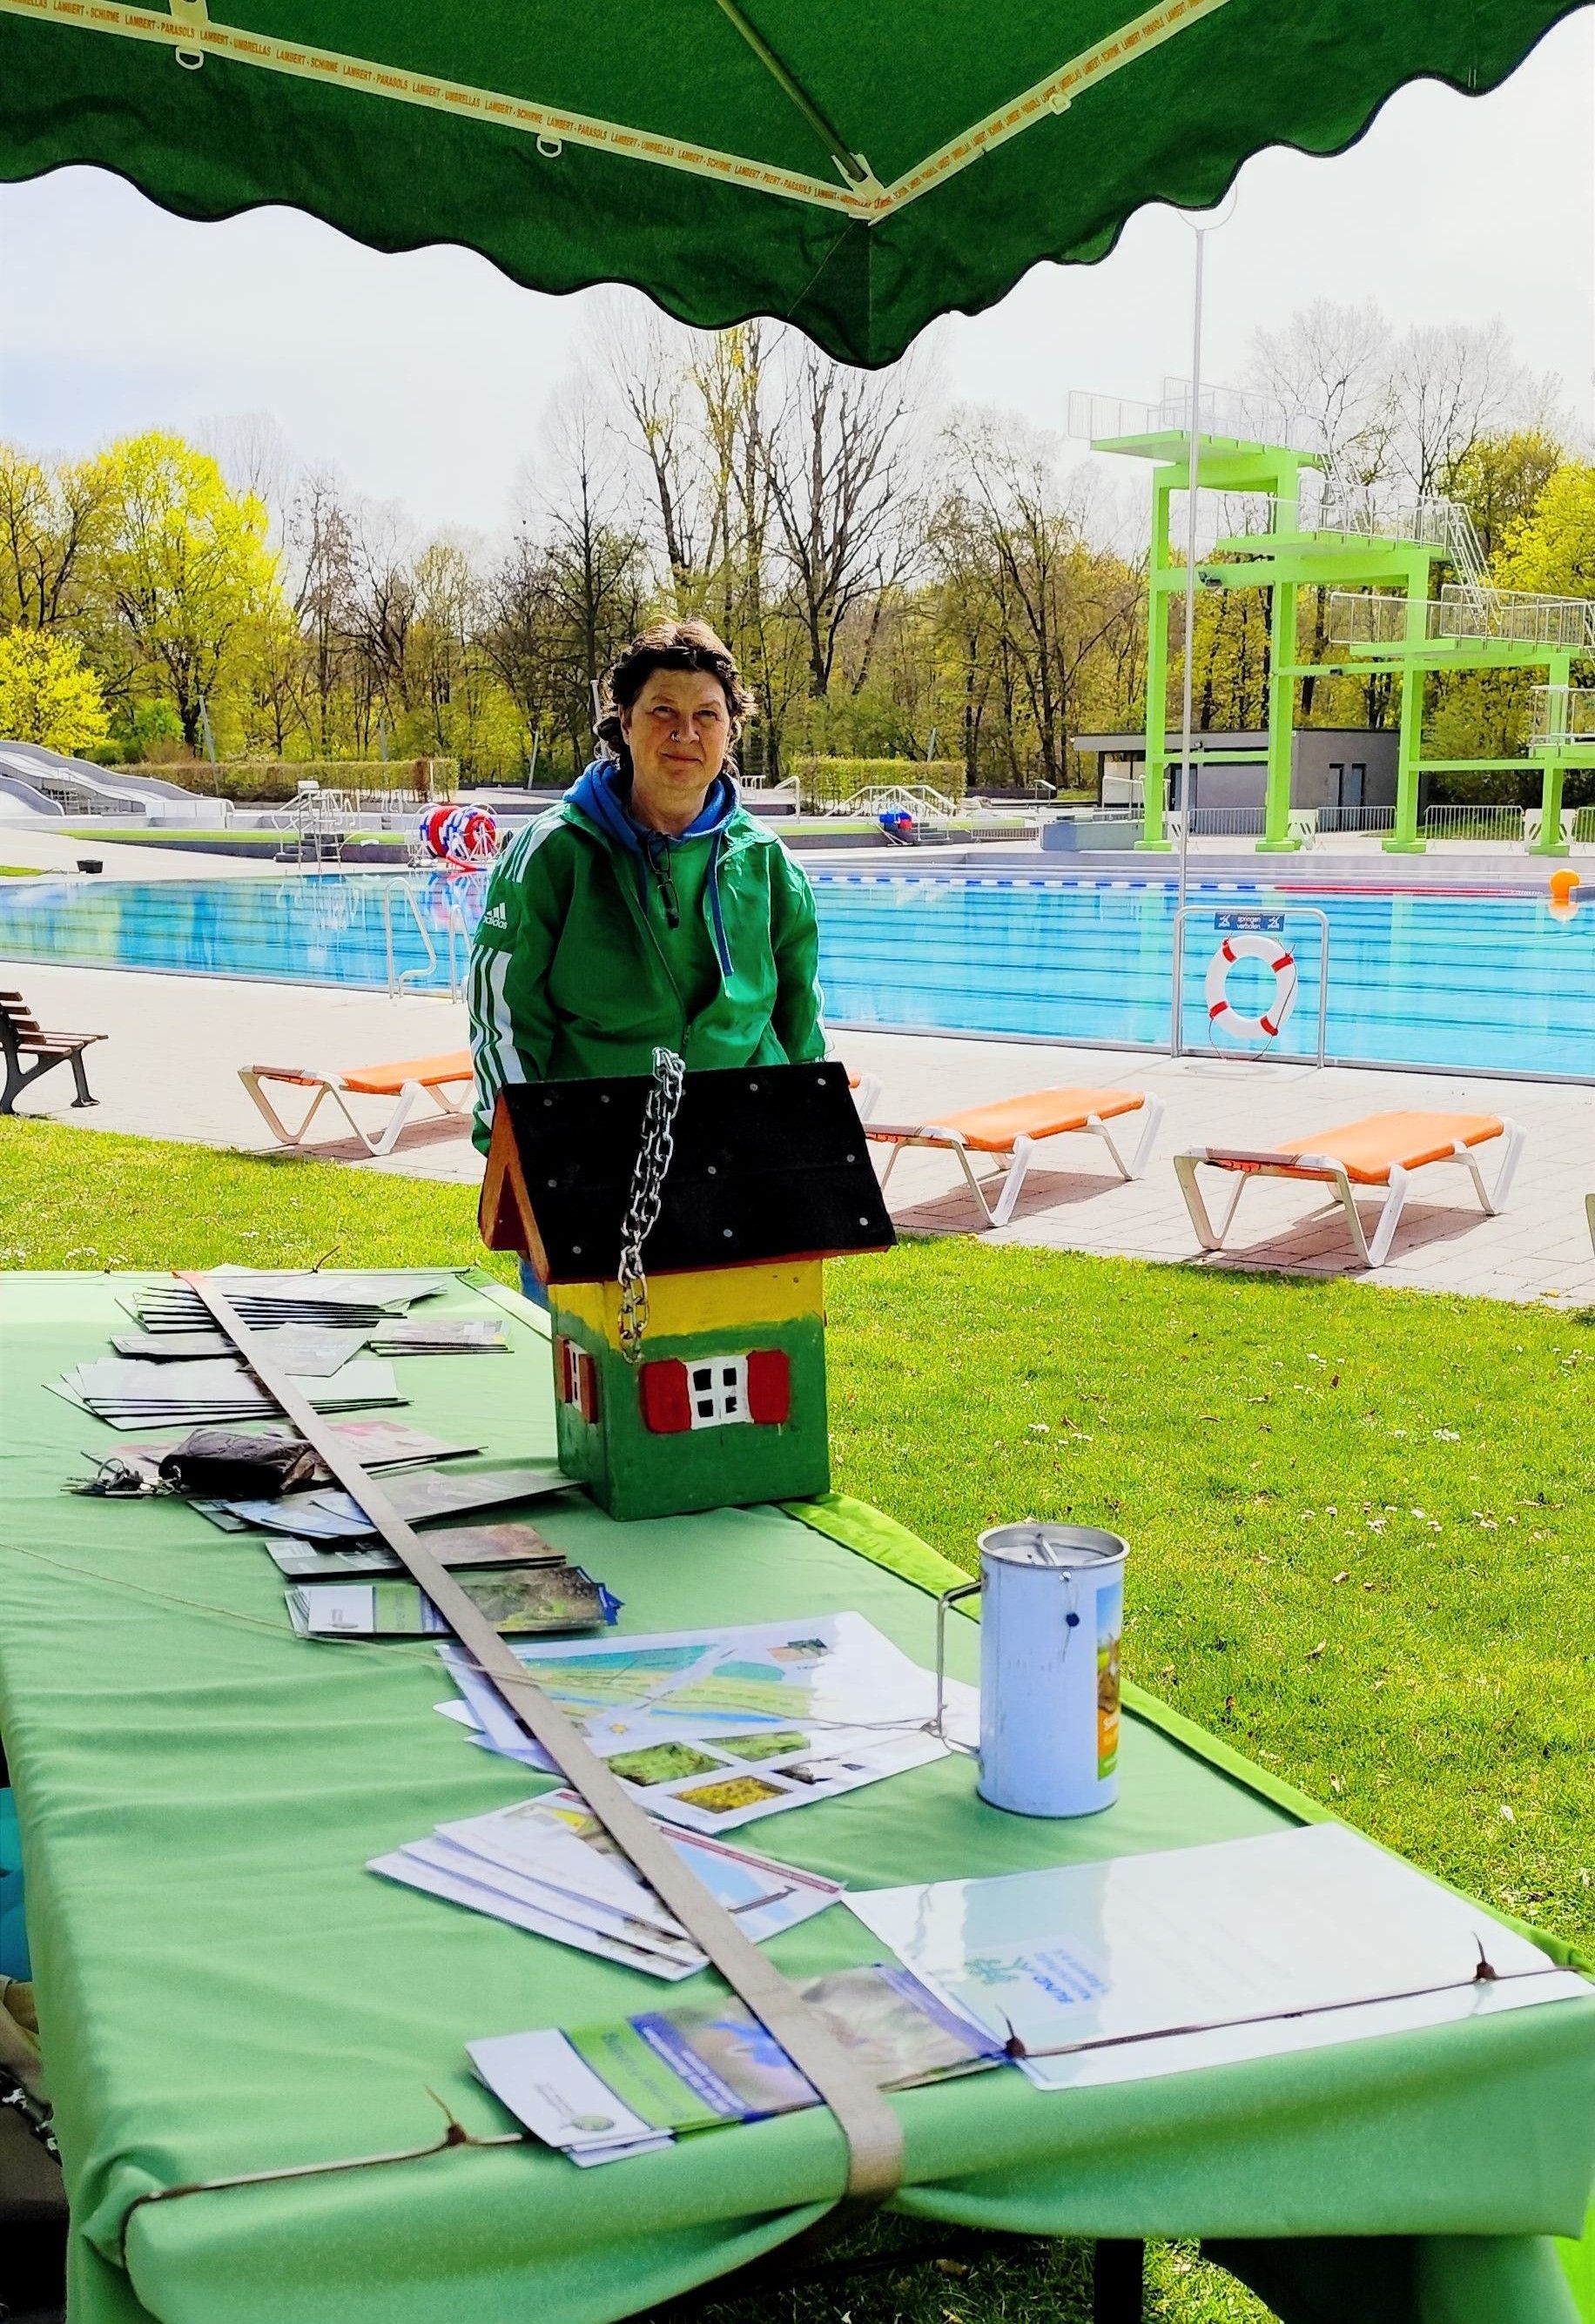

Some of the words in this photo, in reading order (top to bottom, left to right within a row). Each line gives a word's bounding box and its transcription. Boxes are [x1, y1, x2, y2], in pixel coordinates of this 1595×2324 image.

[53, 0, 84, 16] LAMBERT
[125, 11, 156, 30] LAMBERT
[161, 22, 195, 38] PARASOLS
[199, 30, 229, 46] LAMBERT
[233, 37, 272, 57] UMBRELLAS
[276, 48, 306, 66] LAMBERT
[343, 64, 373, 82] LAMBERT
[376, 73, 408, 91] PARASOLS
[412, 82, 441, 98] LAMBERT
[445, 91, 481, 107] UMBRELLAS
[484, 99, 513, 116] LAMBERT
[546, 117, 574, 132] LAMBERT
[577, 124, 608, 141] PARASOLS
[610, 132, 638, 147] LAMBERT
[735, 165, 761, 180] LAMBERT
[482, 915, 508, 930] adidas
